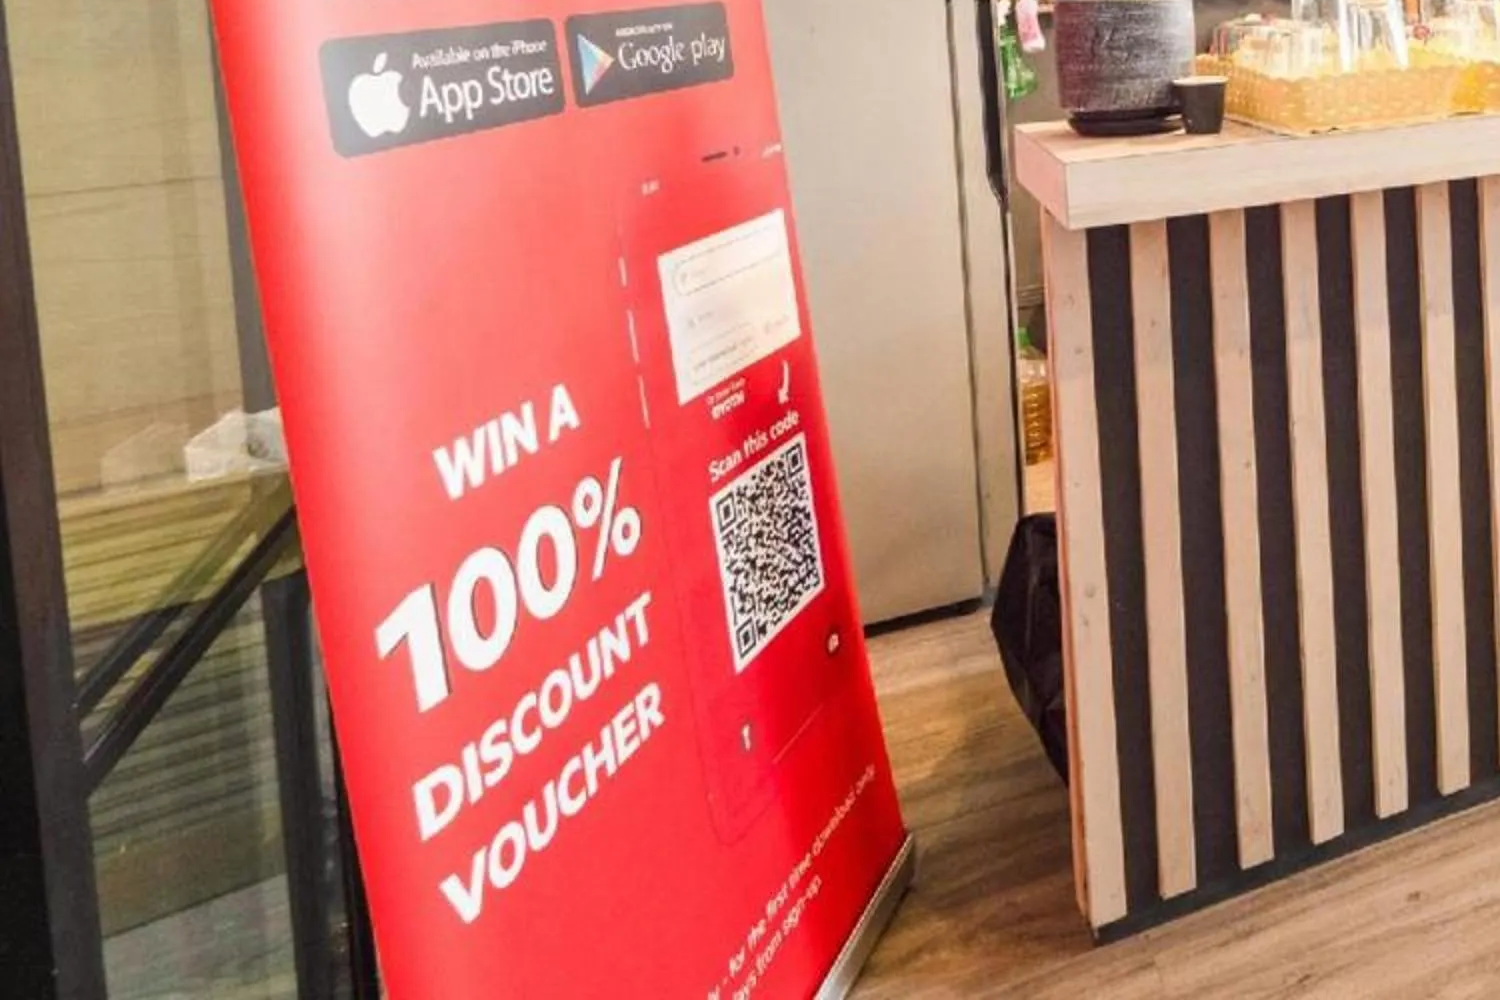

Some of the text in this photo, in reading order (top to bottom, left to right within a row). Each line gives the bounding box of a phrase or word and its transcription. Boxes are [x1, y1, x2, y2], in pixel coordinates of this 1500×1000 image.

[412, 39, 548, 71] Available on the iPhone
[617, 32, 726, 74] Google play
[419, 65, 556, 124] App Store
[432, 382, 582, 502] WIN A
[707, 409, 801, 485] Scan this code
[374, 456, 643, 713] 100%
[411, 592, 653, 842] DISCOUNT
[438, 682, 666, 926] VOUCHER
[748, 919, 767, 952] the
